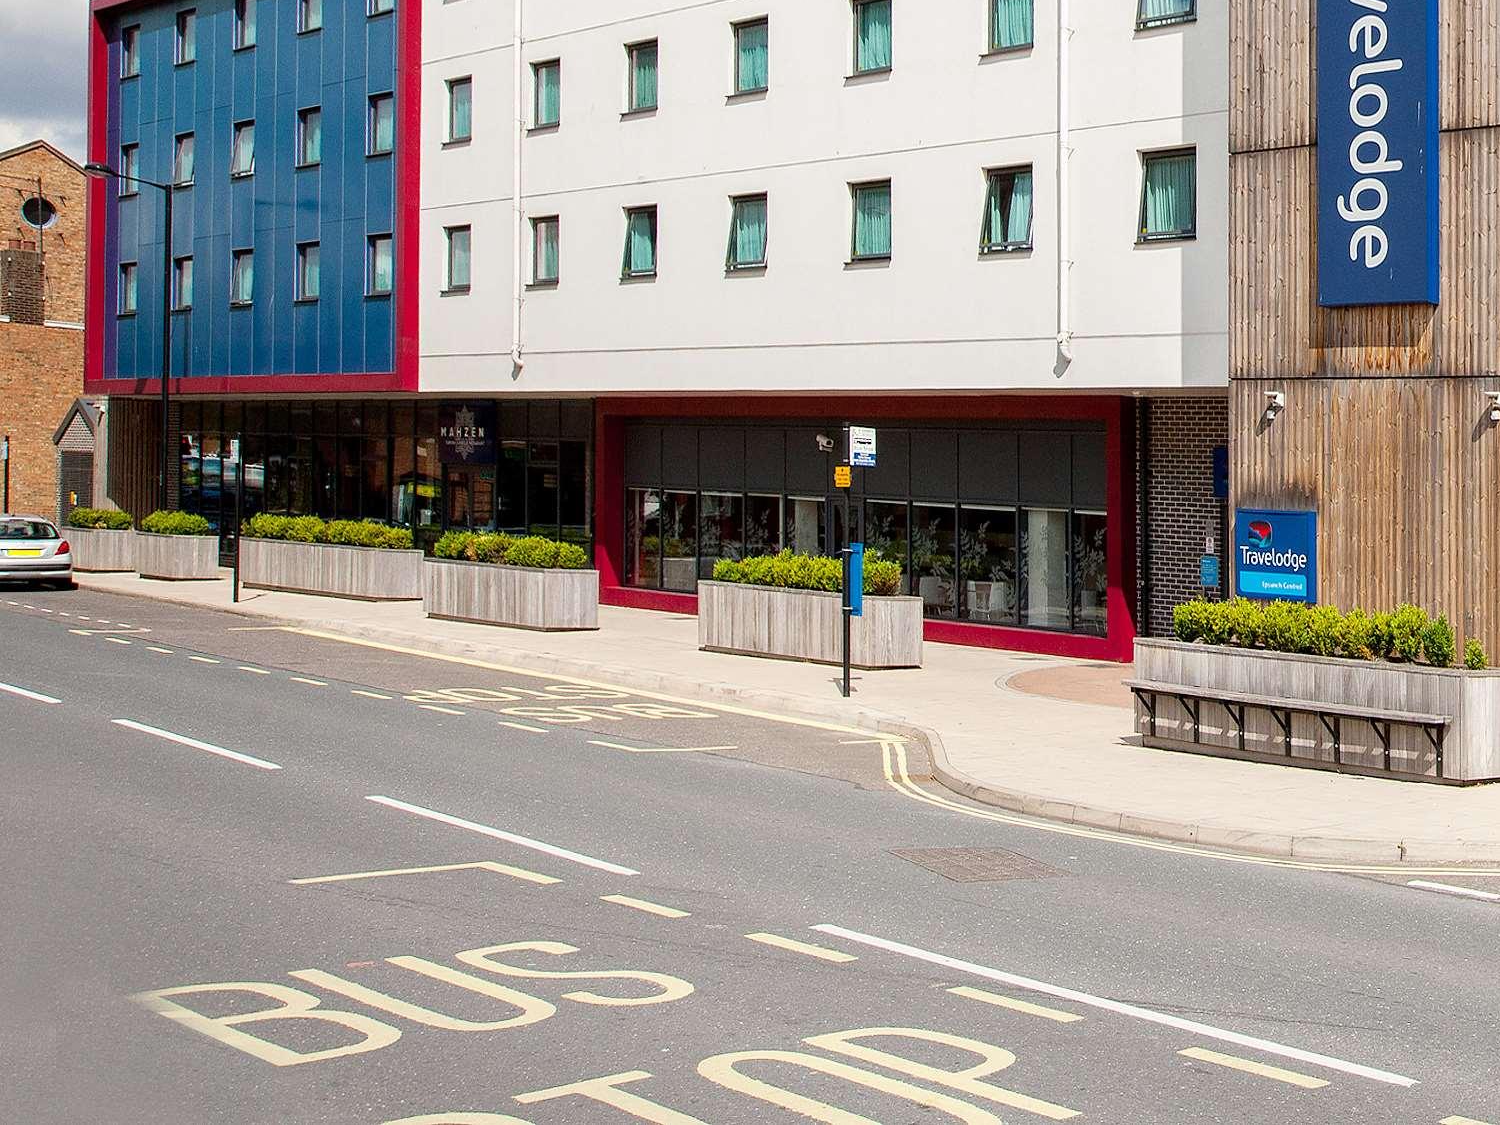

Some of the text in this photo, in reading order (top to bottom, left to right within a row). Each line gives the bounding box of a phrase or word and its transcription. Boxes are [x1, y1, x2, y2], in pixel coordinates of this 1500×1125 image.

[440, 426, 485, 438] MAHZEN
[1239, 545, 1307, 572] Travelodge
[402, 685, 631, 704] STOP
[499, 703, 719, 723] BUS
[128, 940, 695, 1067] BUS
[376, 1027, 1083, 1125] TOP
